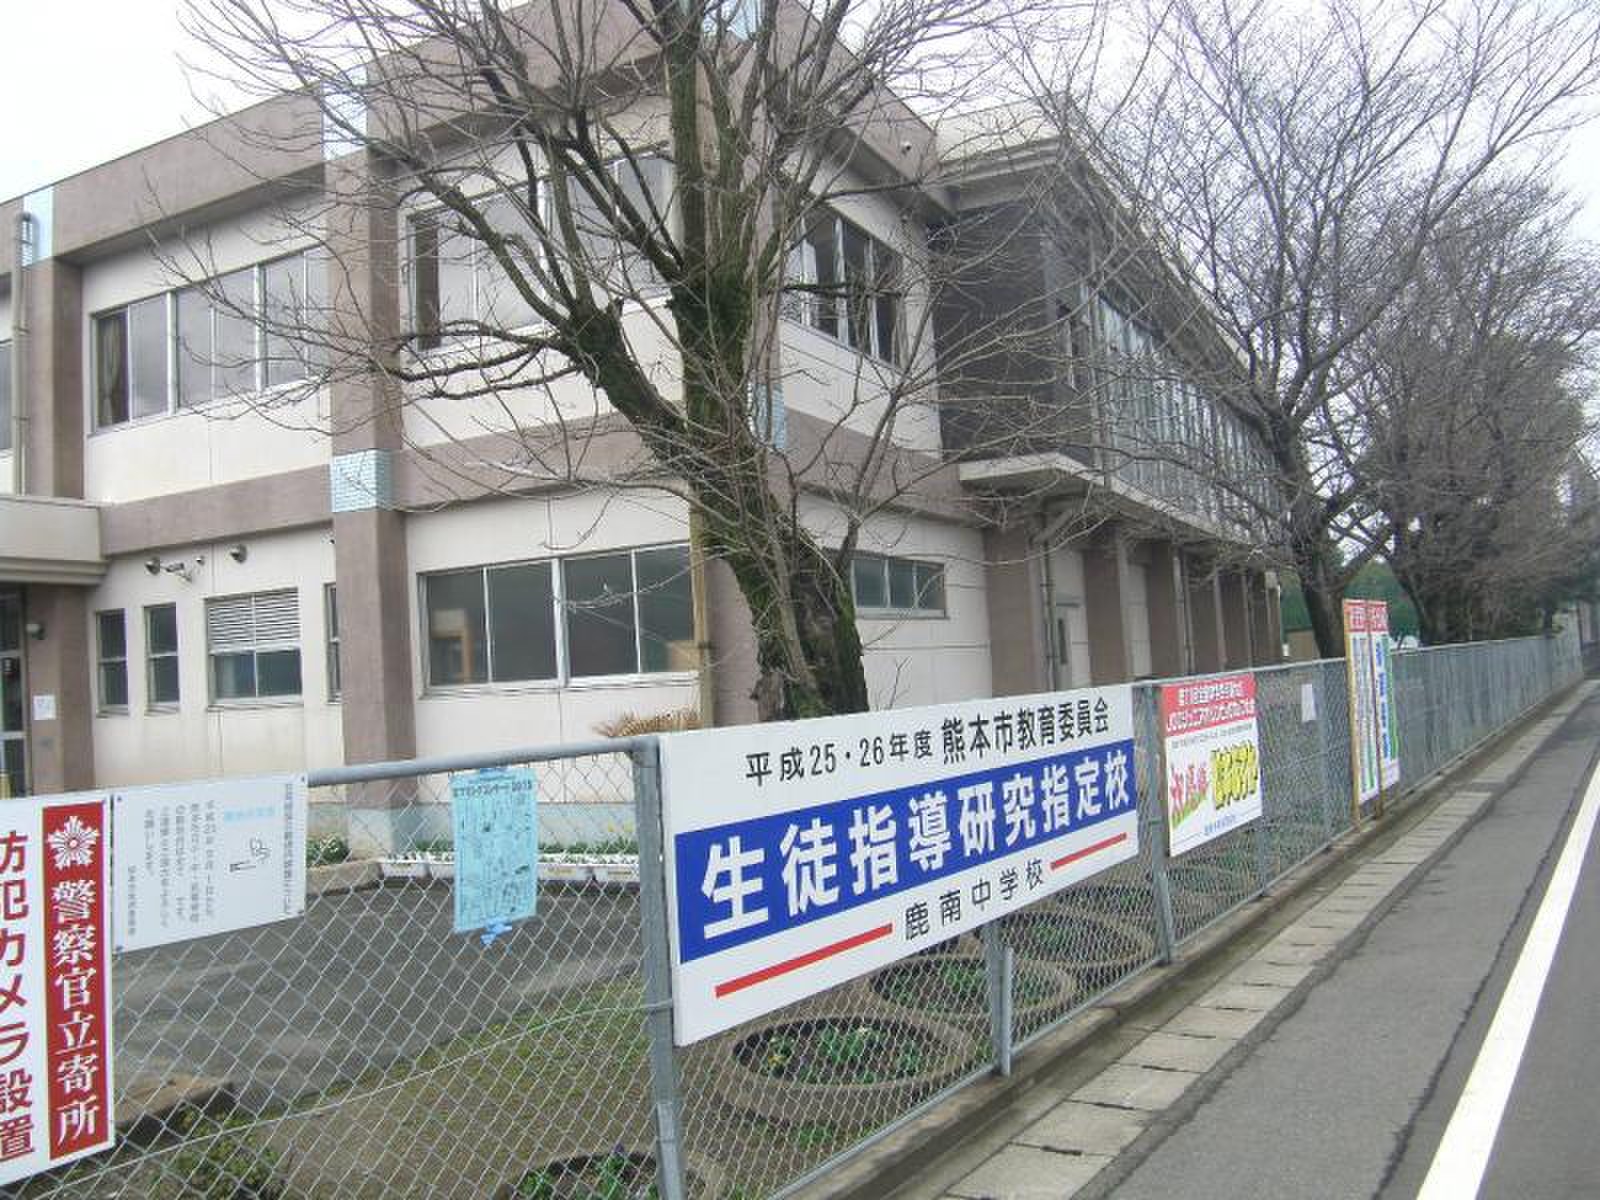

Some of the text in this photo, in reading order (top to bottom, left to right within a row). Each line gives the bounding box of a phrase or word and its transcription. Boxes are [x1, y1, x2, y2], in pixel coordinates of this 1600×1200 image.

[745, 732, 933, 787] 平成25・26年度
[942, 698, 1109, 765] 熊本市教育委員会
[702, 752, 1130, 941] 生徒指導研究指定校
[905, 860, 1045, 941] 鹿南中学校
[51, 879, 98, 1145] 警察官立寄所
